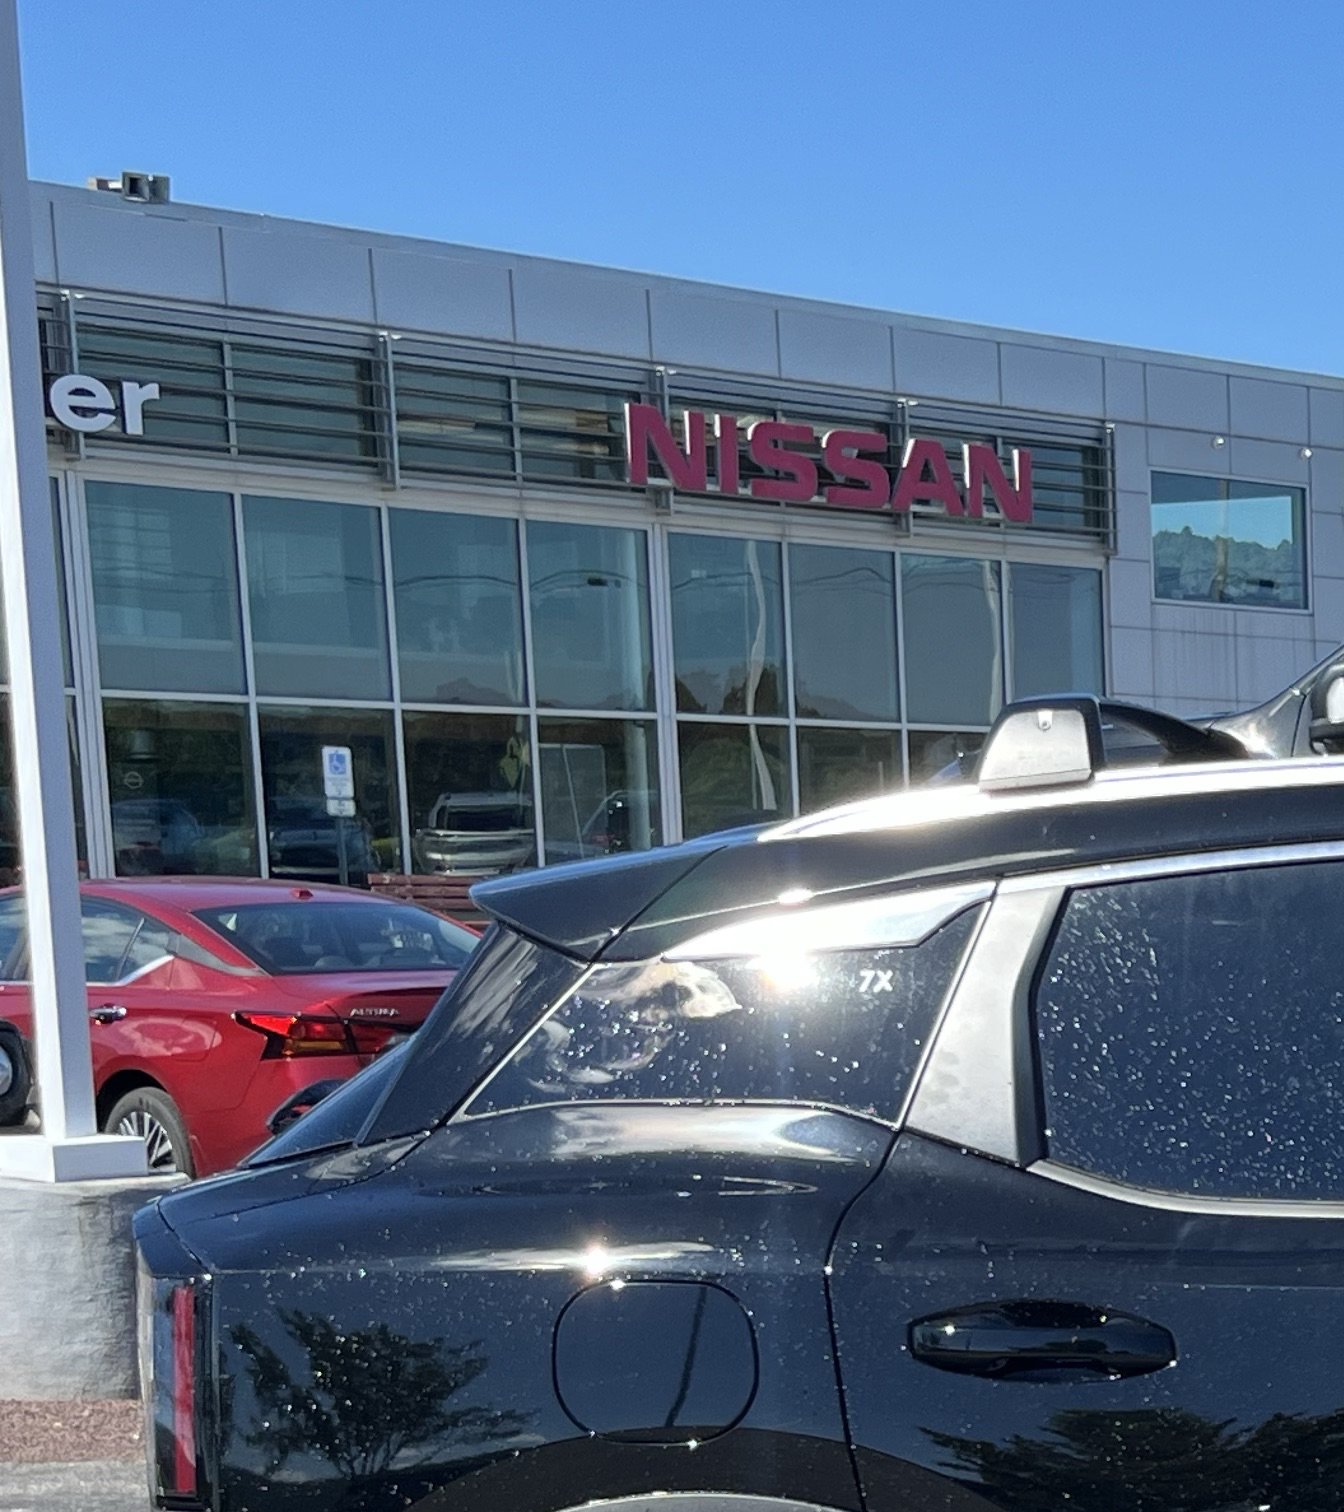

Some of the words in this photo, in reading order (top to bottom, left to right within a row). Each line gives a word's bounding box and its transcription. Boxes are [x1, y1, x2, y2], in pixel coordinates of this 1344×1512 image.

[50, 374, 160, 436] er
[624, 402, 1034, 523] NISSAN
[859, 969, 893, 993] 7X
